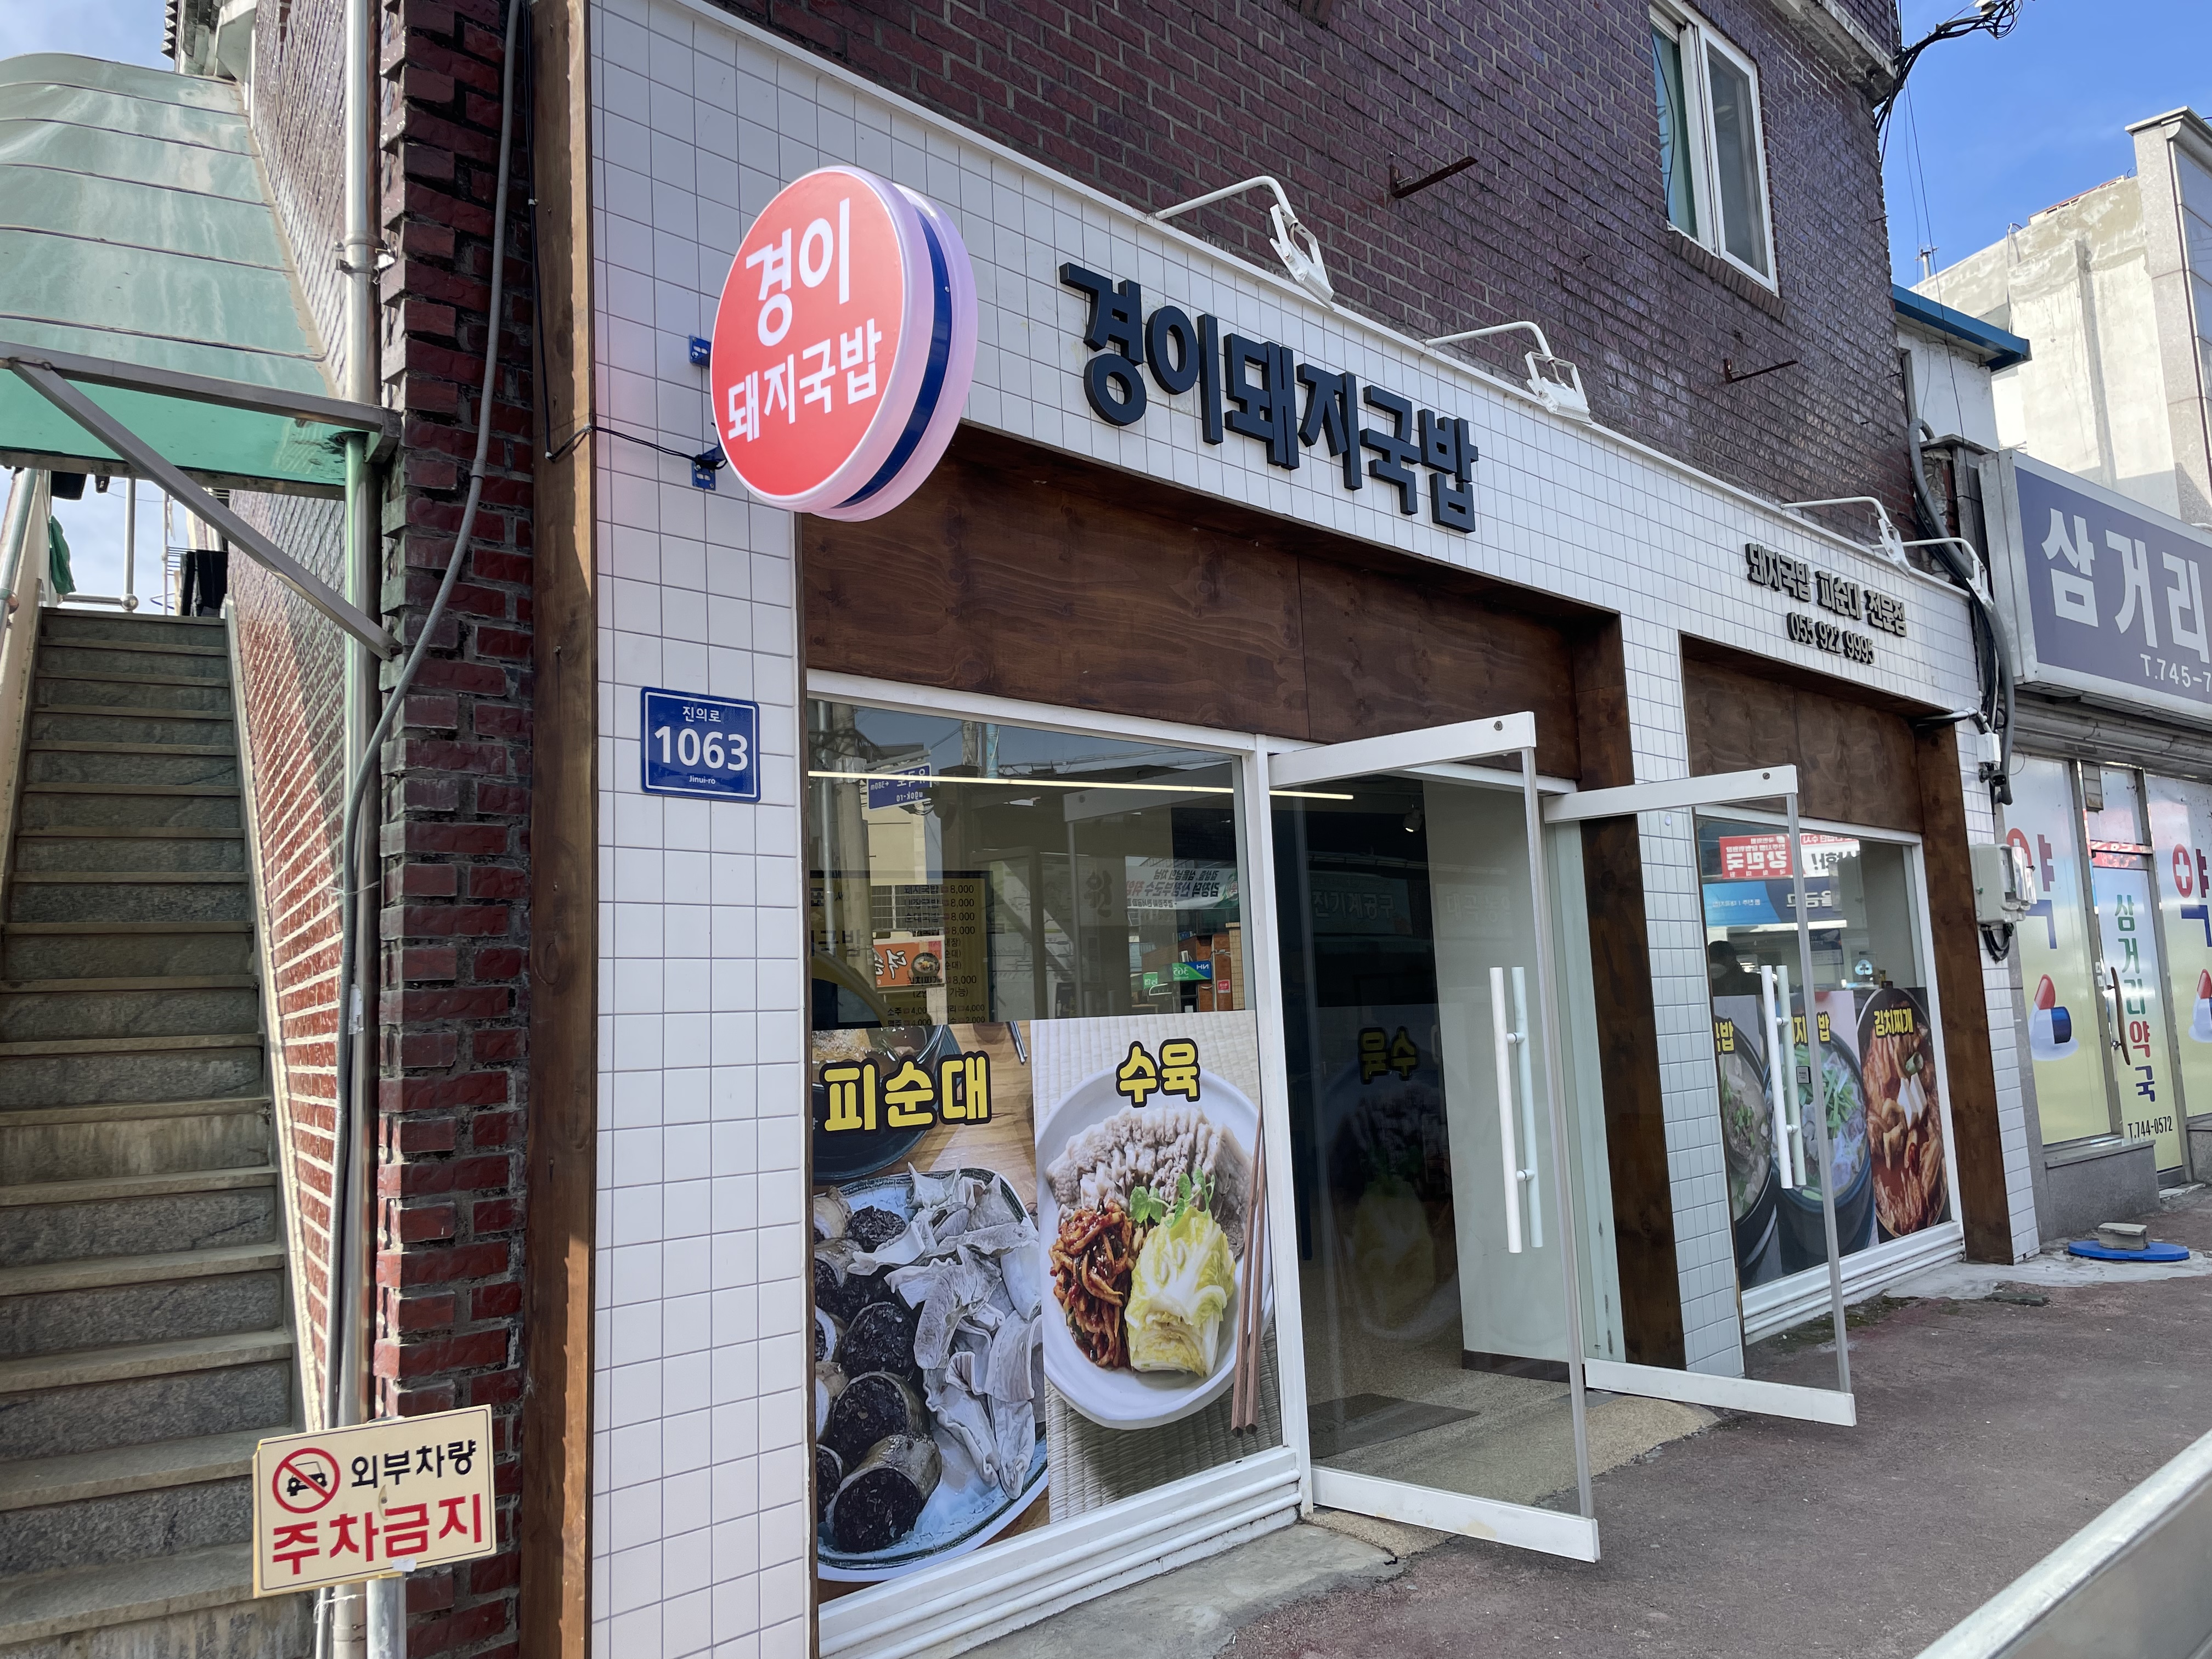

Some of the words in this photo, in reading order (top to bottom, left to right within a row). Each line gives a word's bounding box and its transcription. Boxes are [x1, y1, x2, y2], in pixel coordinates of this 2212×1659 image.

[746, 198, 850, 346] 경이
[728, 318, 882, 442] 돼지국밥
[1745, 543, 1811, 602] 돼지국밥
[1815, 571, 1861, 620] 피순대
[1864, 590, 1907, 637] 전문점
[2041, 507, 2210, 664] 삼거리
[1787, 612, 1815, 644] 055
[1815, 620, 1842, 653] 922
[1842, 631, 1875, 664] 9995
[2140, 653, 2211, 692] T.745-7
[682, 706, 721, 723] 진의로
[654, 726, 748, 771] 1063
[689, 775, 716, 785] Jinui-ro
[950, 885, 974, 894] 8,000
[950, 899, 975, 908] 8,000
[951, 912, 975, 922] 8,000
[951, 926, 975, 935] 8,000
[950, 988, 969, 997] 가능)
[953, 975, 977, 985] 8,000
[966, 1005, 985, 1013] 4,000
[1874, 1007, 1914, 1036] 김치찌개
[823, 1054, 989, 1133] 피순대
[1118, 1041, 1200, 1104] 수육
[2128, 1115, 2173, 1139] T.744-0572
[351, 1440, 476, 1489] 외부차량
[272, 1493, 482, 1576] 주차금지
